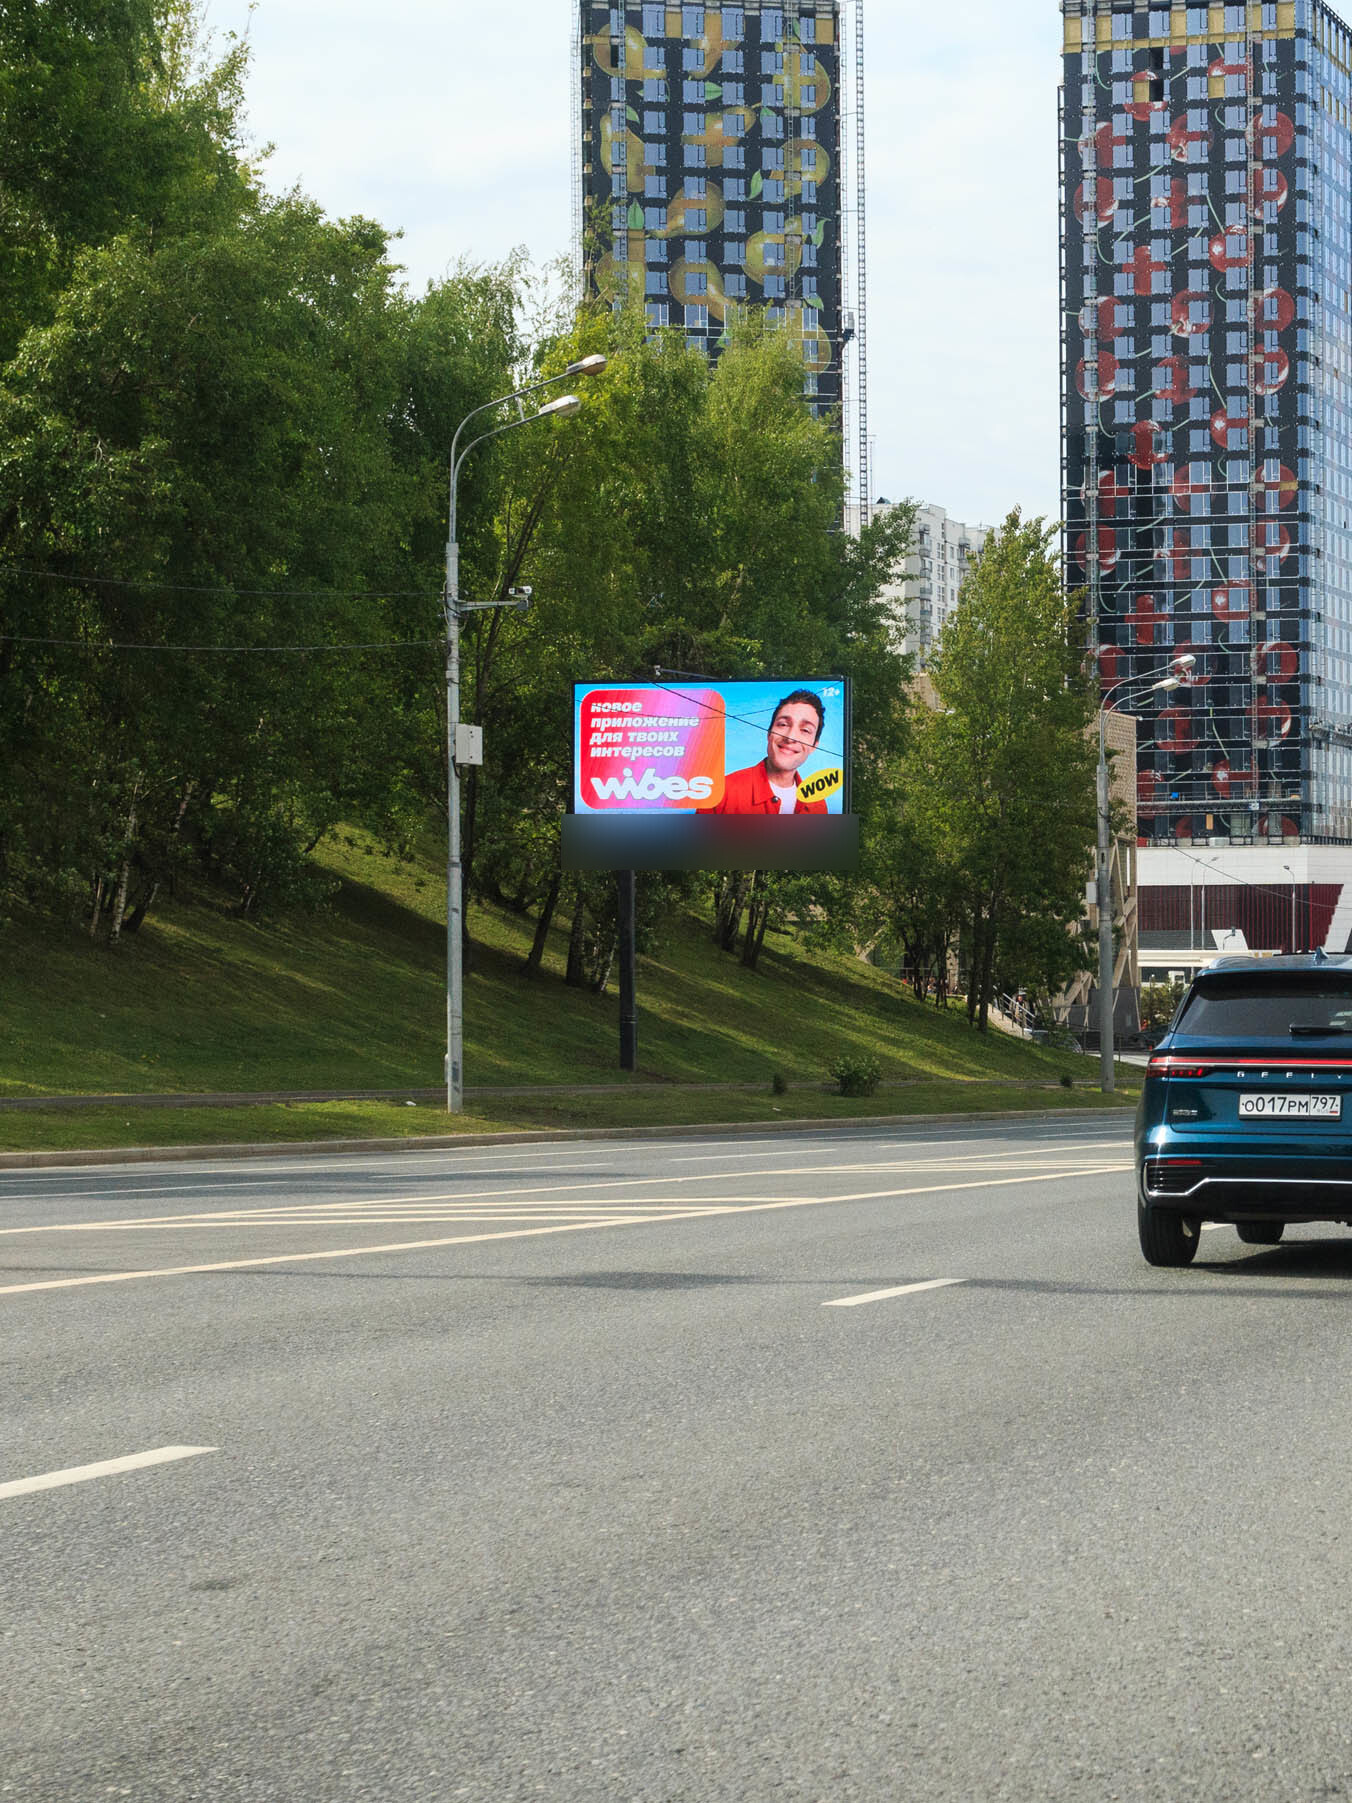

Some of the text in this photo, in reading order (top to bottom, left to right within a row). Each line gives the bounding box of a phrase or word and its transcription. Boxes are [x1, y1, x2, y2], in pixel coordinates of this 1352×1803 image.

[823, 687, 840, 697] 12+
[591, 702, 643, 713] новое
[591, 716, 700, 731] приложение
[589, 731, 679, 745] для твоих
[590, 746, 685, 761] интересов
[590, 767, 713, 801] wibes
[1311, 1096, 1336, 1110] 797
